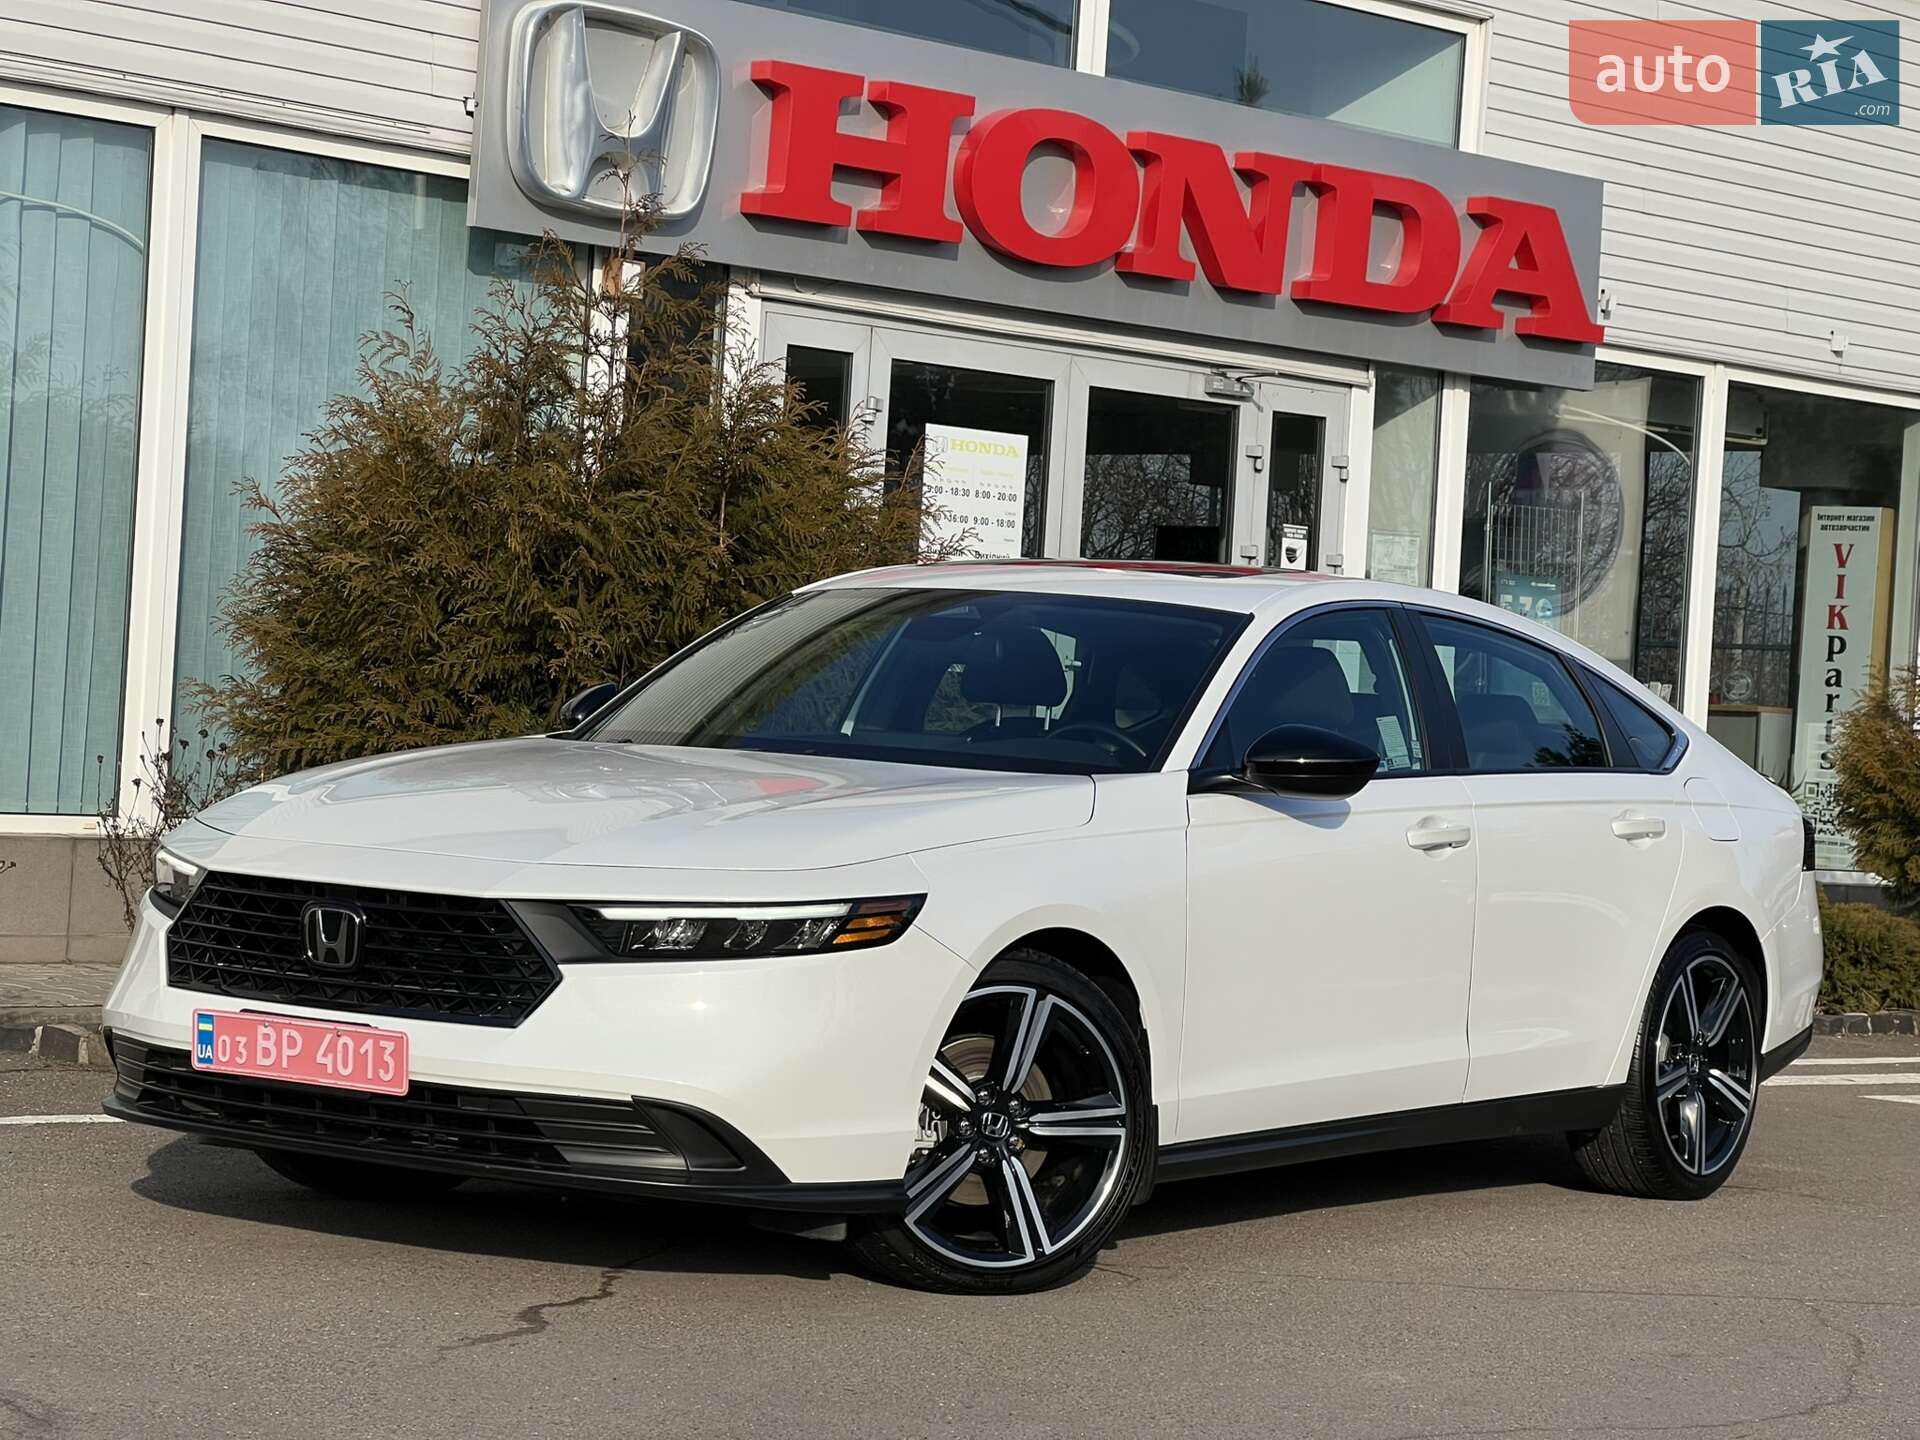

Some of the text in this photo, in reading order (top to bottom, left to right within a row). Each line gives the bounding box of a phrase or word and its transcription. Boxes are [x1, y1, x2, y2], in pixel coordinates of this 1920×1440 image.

[740, 59, 1605, 344] HONDA
[950, 438, 1019, 458] HONDA
[950, 487, 970, 497] 18:30
[975, 490, 991, 500] 8:00
[997, 492, 1017, 503] 20:00
[973, 516, 989, 526] 9:00
[996, 518, 1016, 529] 18:00
[198, 1044, 213, 1060] UA
[217, 1034, 249, 1065] 03
[316, 1031, 396, 1082] 4013
